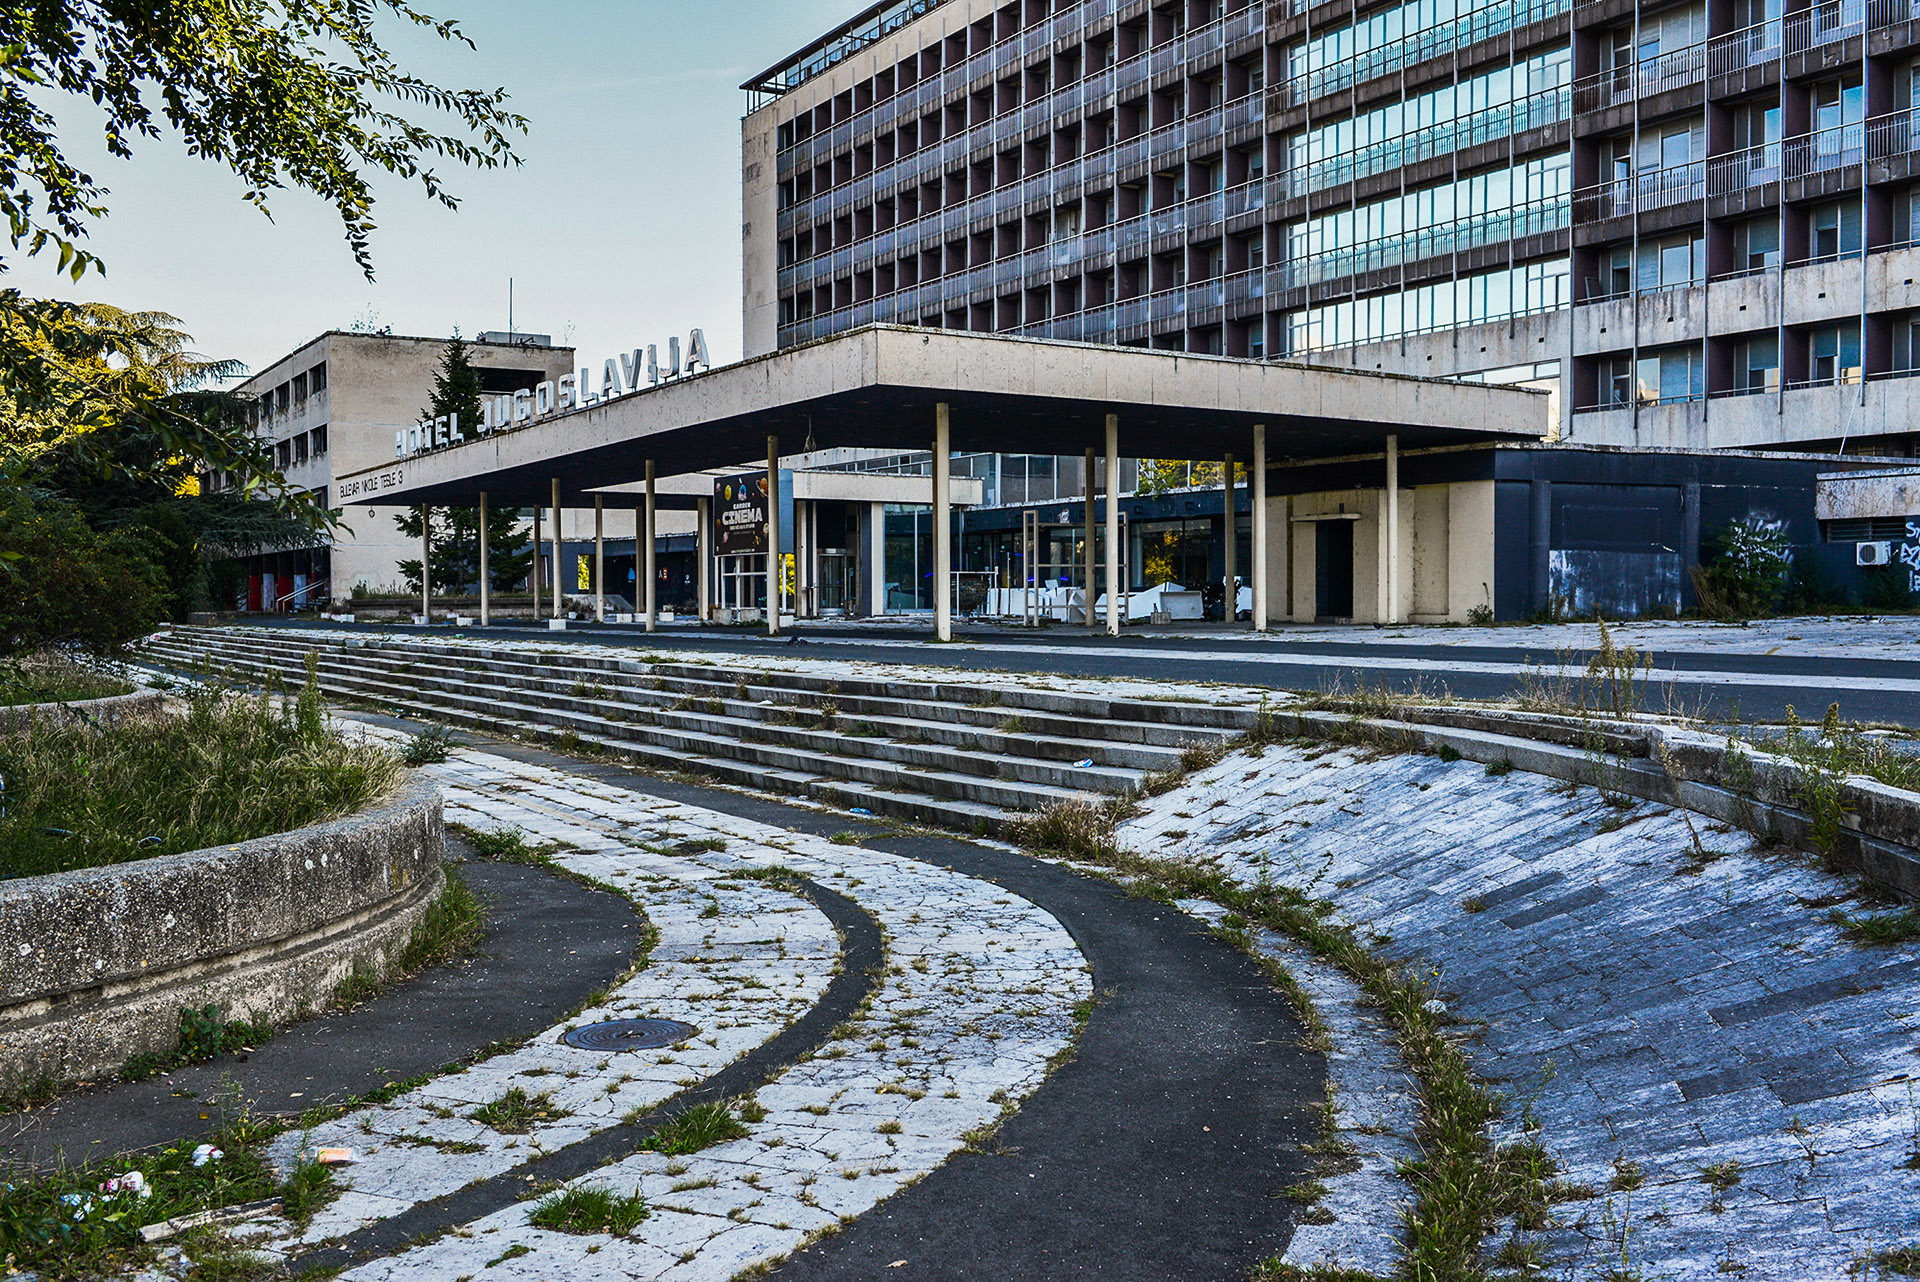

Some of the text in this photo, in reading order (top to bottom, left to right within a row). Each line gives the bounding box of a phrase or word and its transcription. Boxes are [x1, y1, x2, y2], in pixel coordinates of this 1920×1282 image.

[395, 328, 710, 458] HOTEL JUGOSLAVIJA
[380, 472, 396, 488] TESLE
[397, 470, 403, 485] 3
[722, 507, 763, 526] CINEMA
